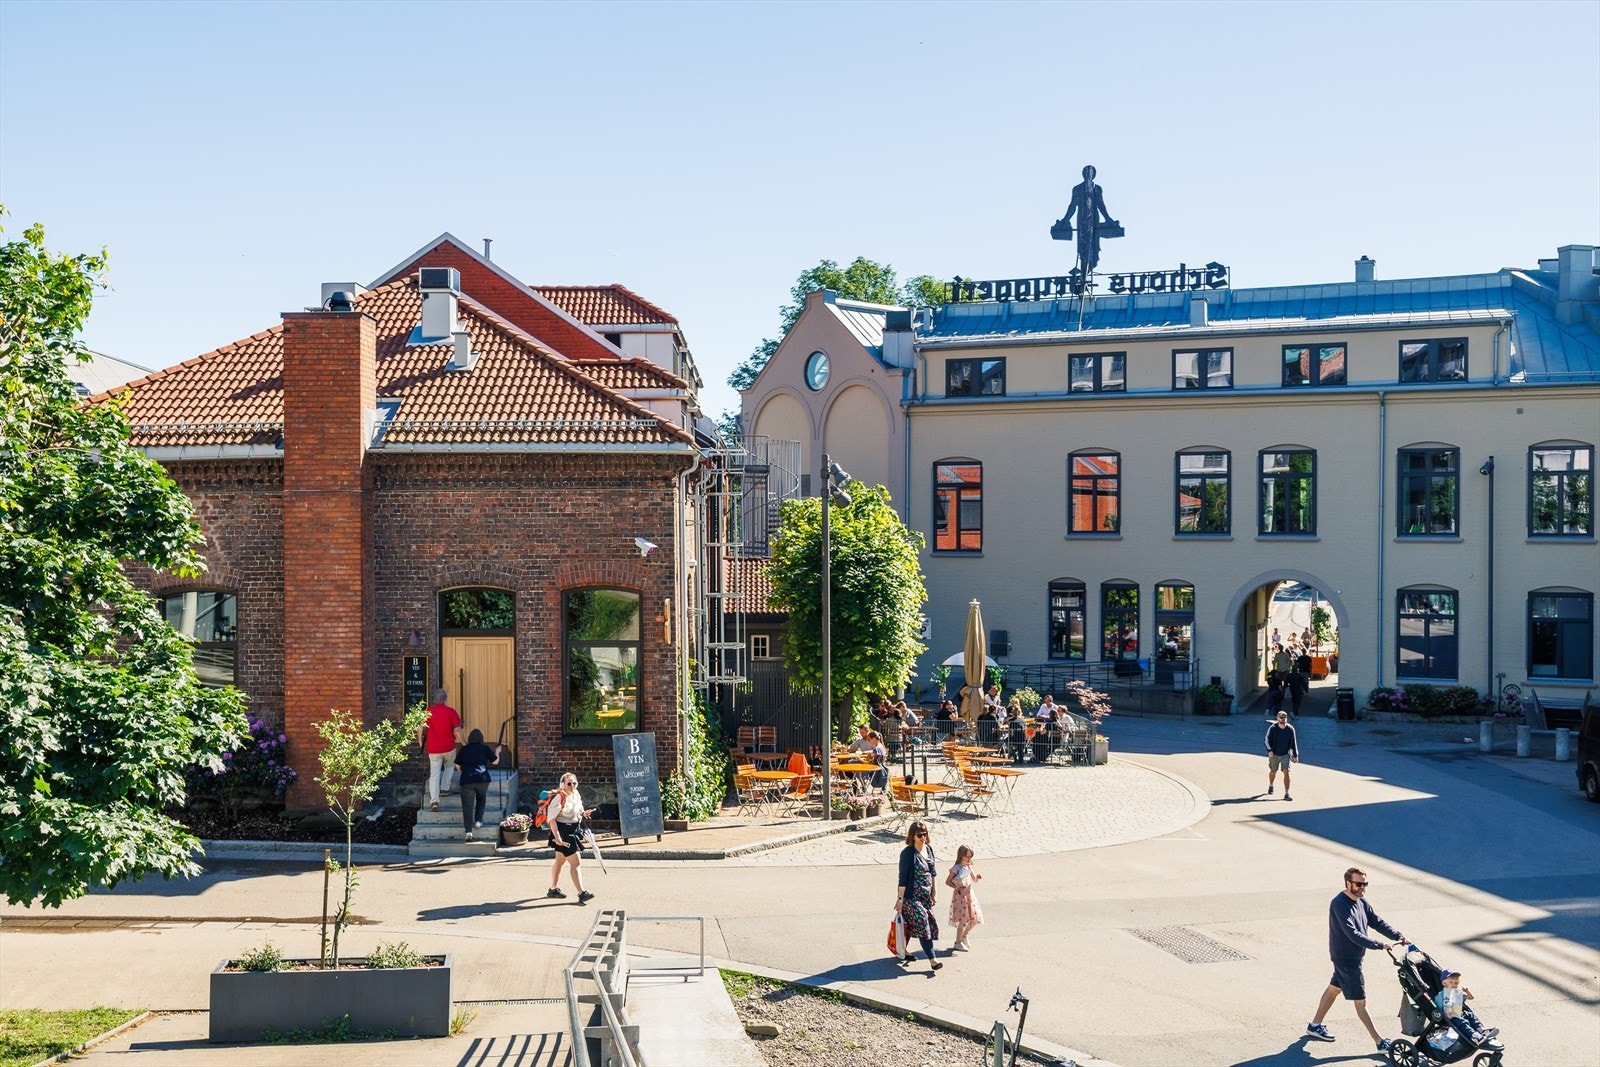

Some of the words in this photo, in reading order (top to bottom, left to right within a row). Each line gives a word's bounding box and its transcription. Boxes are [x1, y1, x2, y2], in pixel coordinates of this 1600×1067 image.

[412, 658, 418, 666] B
[630, 738, 640, 754] B
[628, 755, 644, 764] VIN
